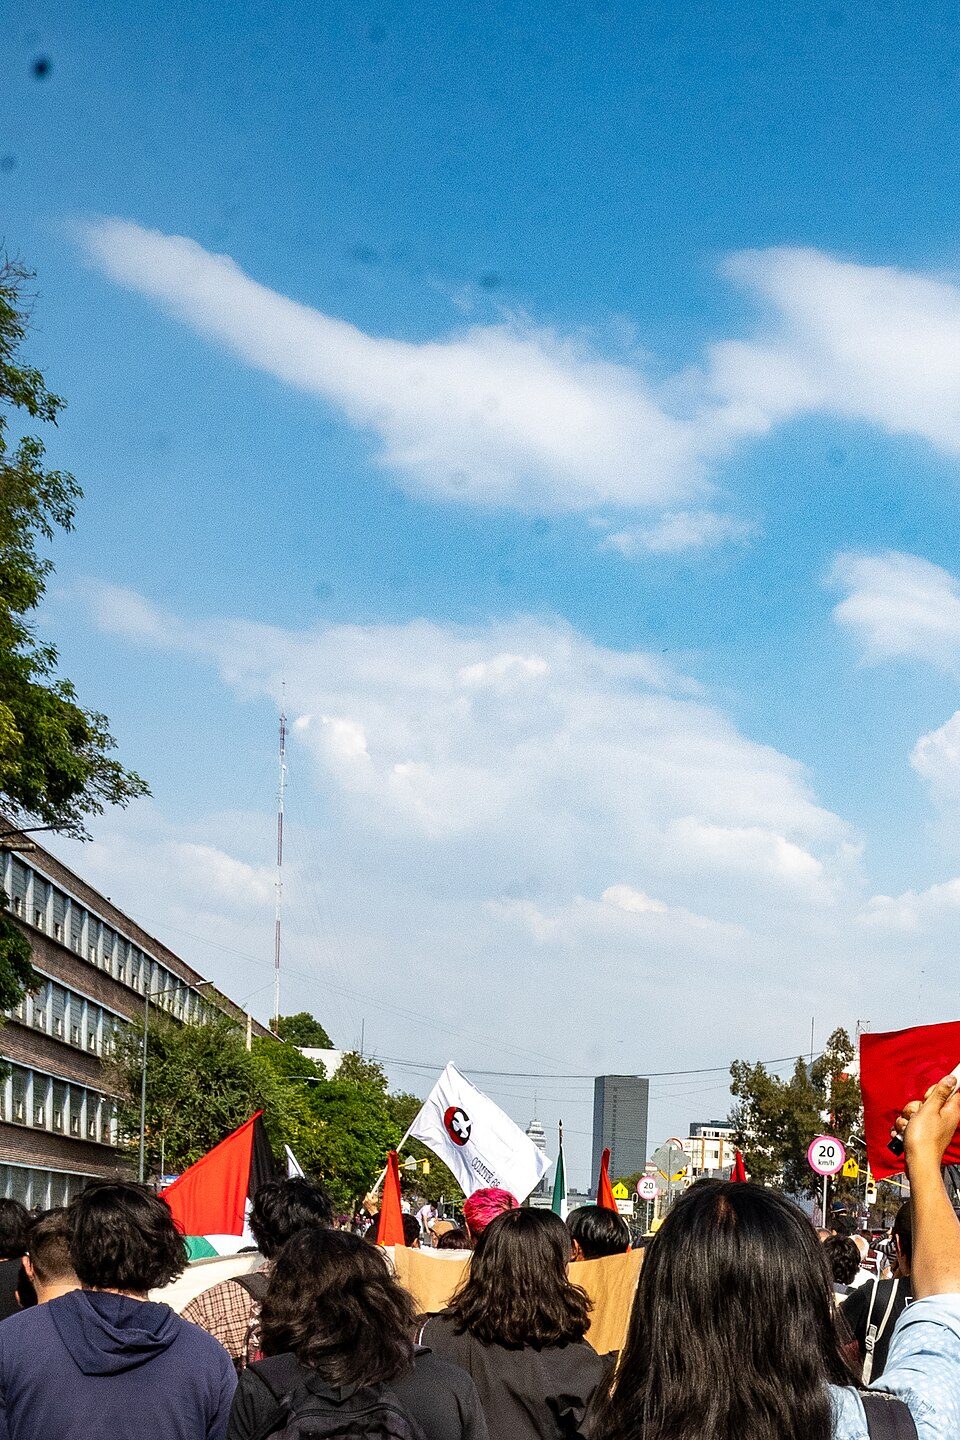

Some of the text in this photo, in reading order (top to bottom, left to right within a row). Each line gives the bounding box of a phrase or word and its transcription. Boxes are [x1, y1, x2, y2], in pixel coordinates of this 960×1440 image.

[819, 1146, 835, 1158] 20
[471, 1157, 495, 1184] COMITÉ
[643, 1182, 654, 1190] 20
